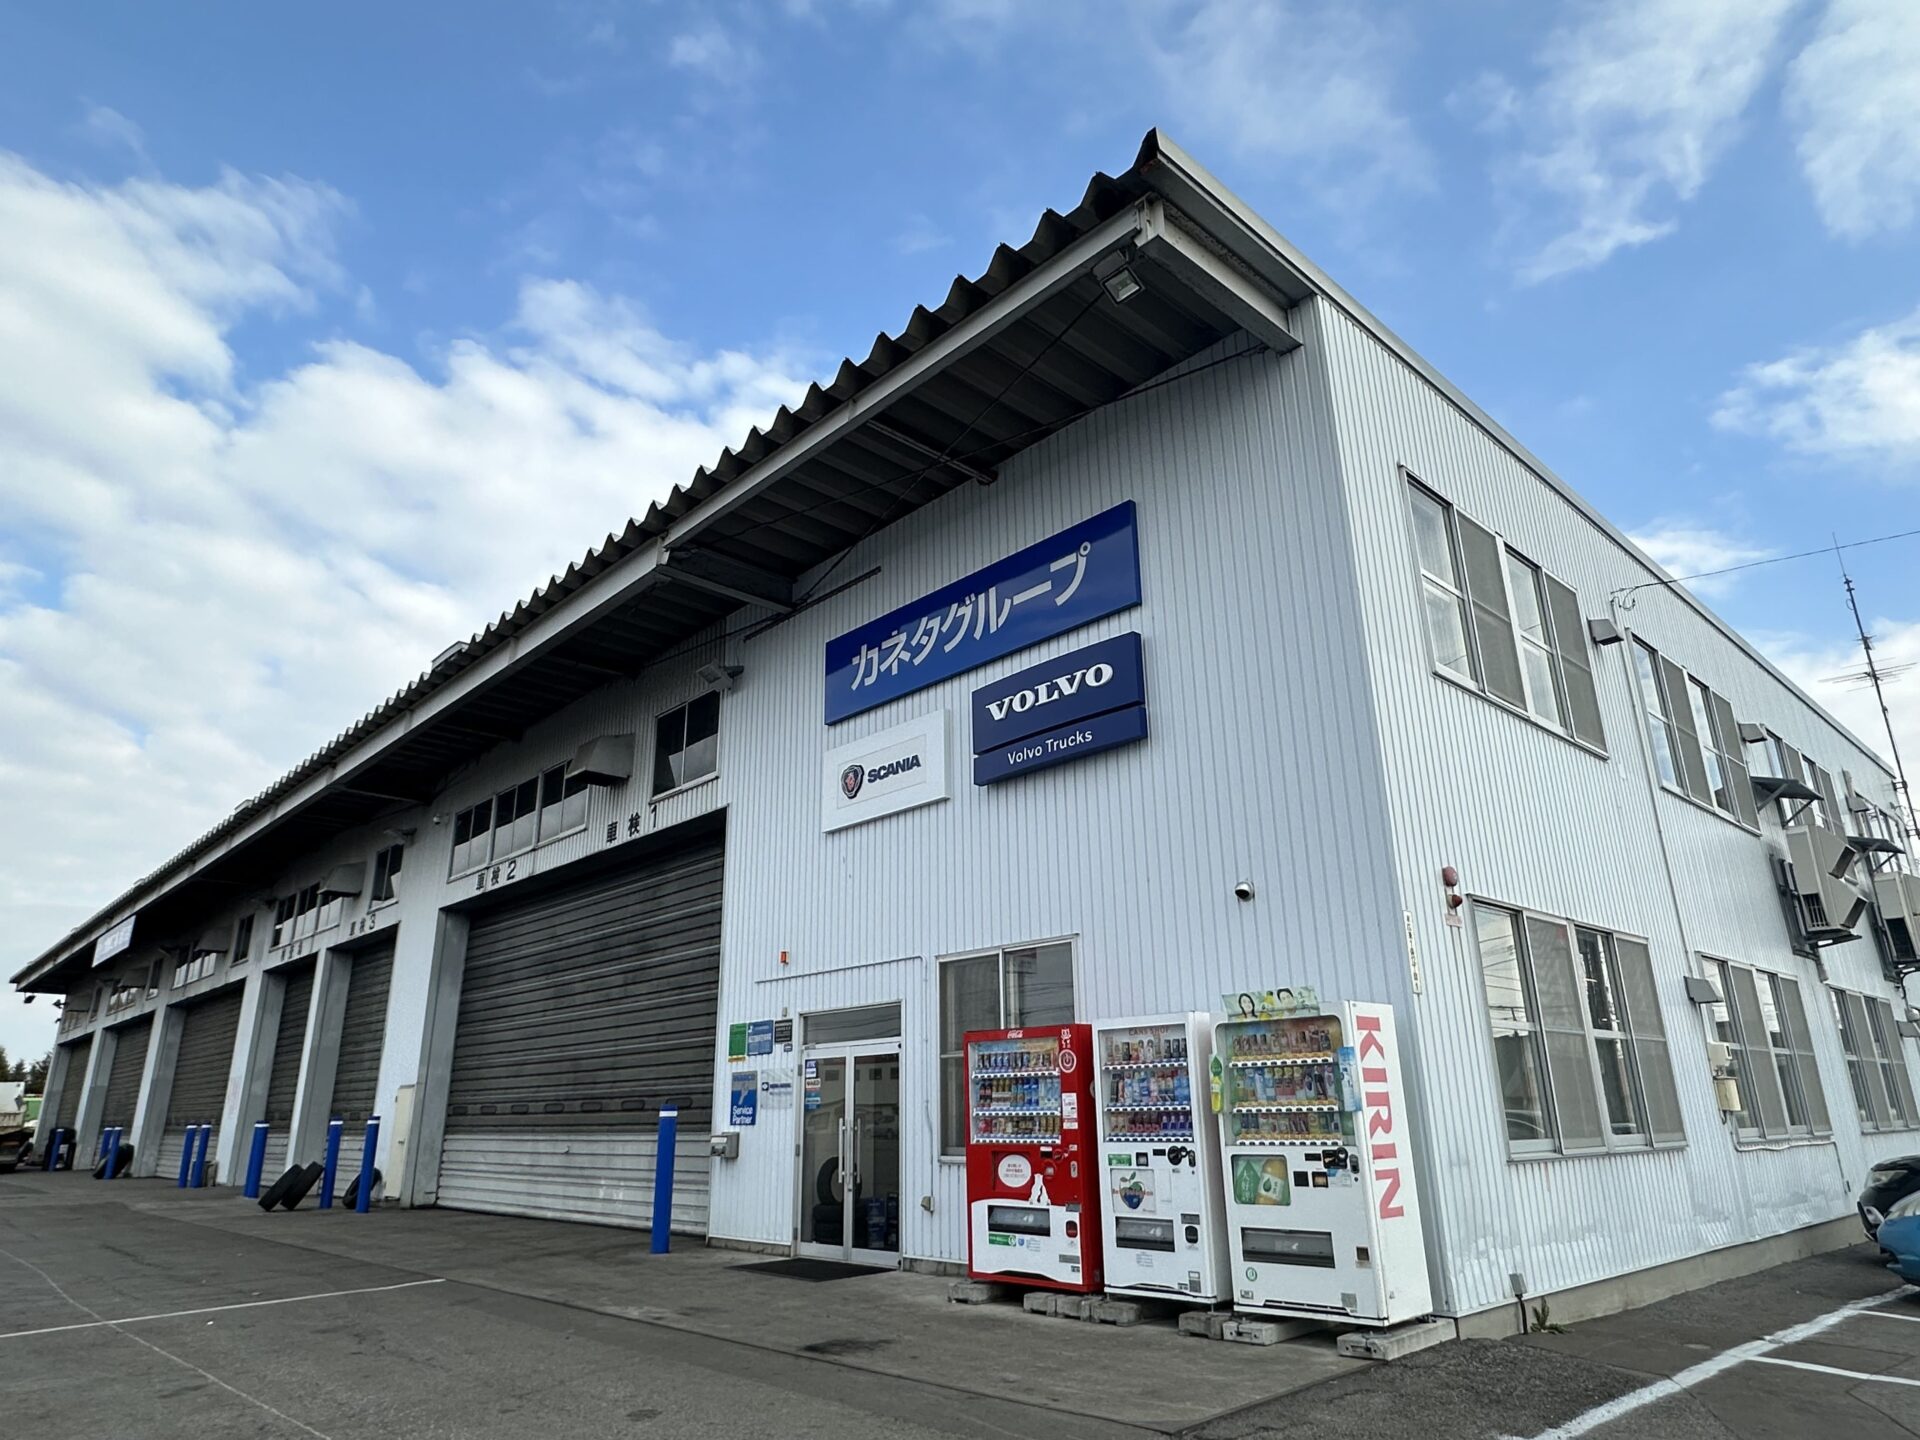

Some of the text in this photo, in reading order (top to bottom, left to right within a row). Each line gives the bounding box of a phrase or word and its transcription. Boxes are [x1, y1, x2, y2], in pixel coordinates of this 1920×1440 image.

[850, 541, 1091, 691] カネタグループ
[985, 663, 1114, 721] VOLVO
[867, 754, 922, 784] SCANIA
[1007, 730, 1093, 765] Volvo Trucks
[1355, 1015, 1405, 1220] KIRIN
